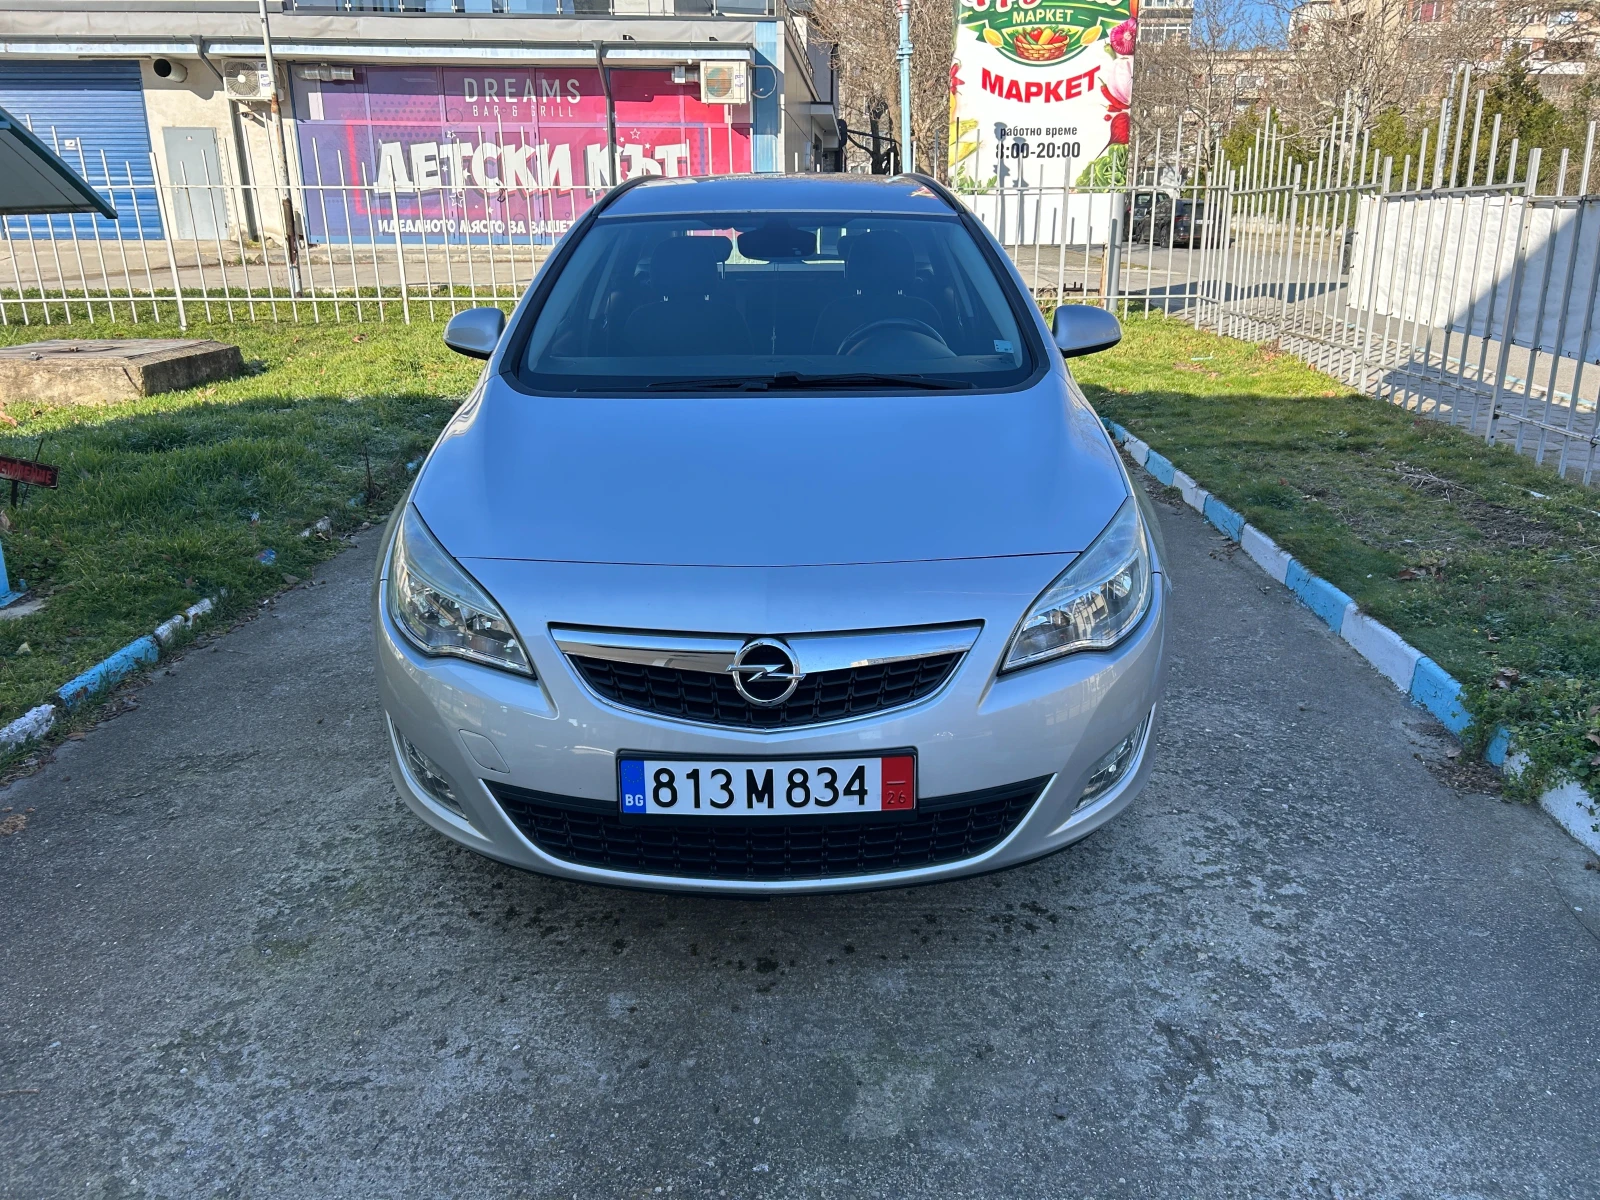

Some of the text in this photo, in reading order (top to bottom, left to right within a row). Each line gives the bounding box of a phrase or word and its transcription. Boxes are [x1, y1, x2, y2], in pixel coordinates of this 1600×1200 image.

[1012, 9, 1074, 24] МАРКЕТ
[463, 77, 581, 104] DREAMS
[981, 65, 1101, 103] МАРКЕТ
[472, 105, 573, 117] BAR & GRILL
[1000, 126, 1078, 139] работно време
[996, 141, 1081, 159] 8:00-20:00
[373, 142, 688, 193] ДЕТСКИ КЪТ
[378, 219, 456, 233] ИДЕАЛНОТО
[460, 219, 505, 234] МЯСТО
[625, 793, 644, 807] BG
[887, 790, 906, 805] 26
